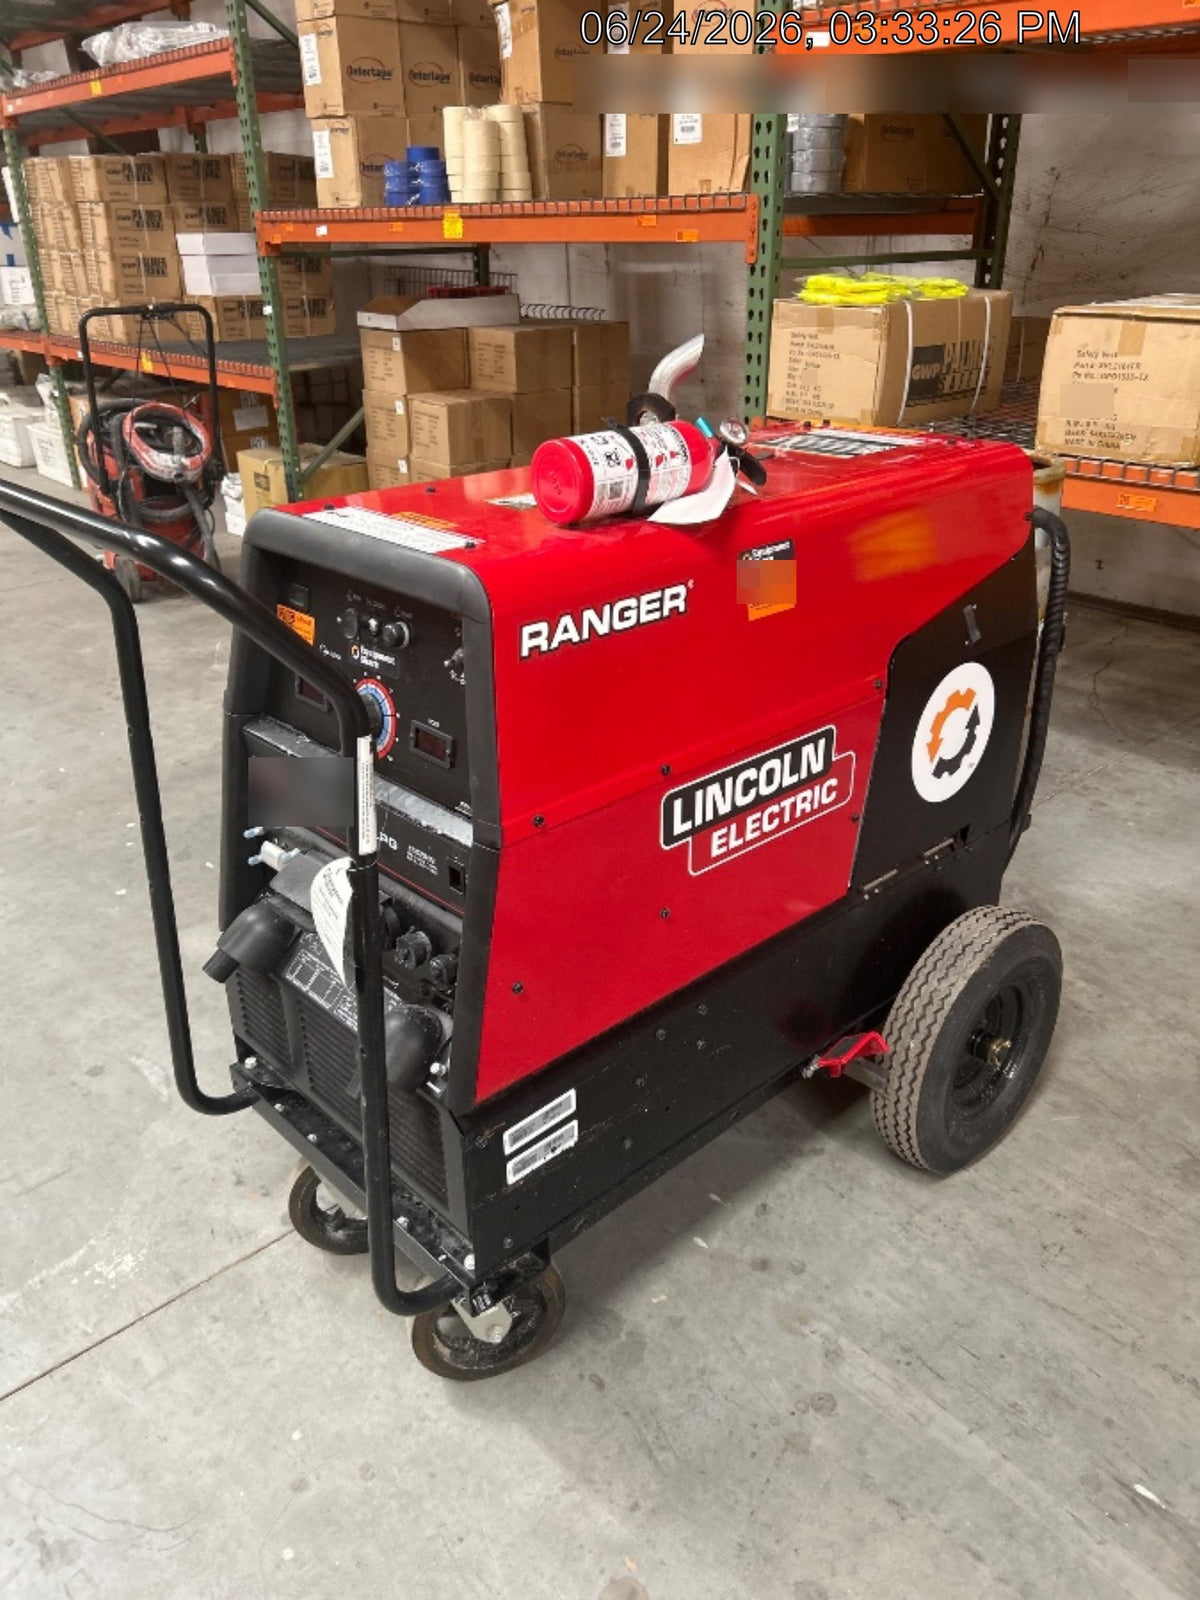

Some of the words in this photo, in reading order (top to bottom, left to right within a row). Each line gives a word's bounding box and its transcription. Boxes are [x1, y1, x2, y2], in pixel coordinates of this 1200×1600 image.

[911, 363, 941, 381] GWP
[520, 584, 688, 658] RANGER
[673, 737, 826, 837] LINCOLN
[711, 777, 839, 858] ELECTRIC
